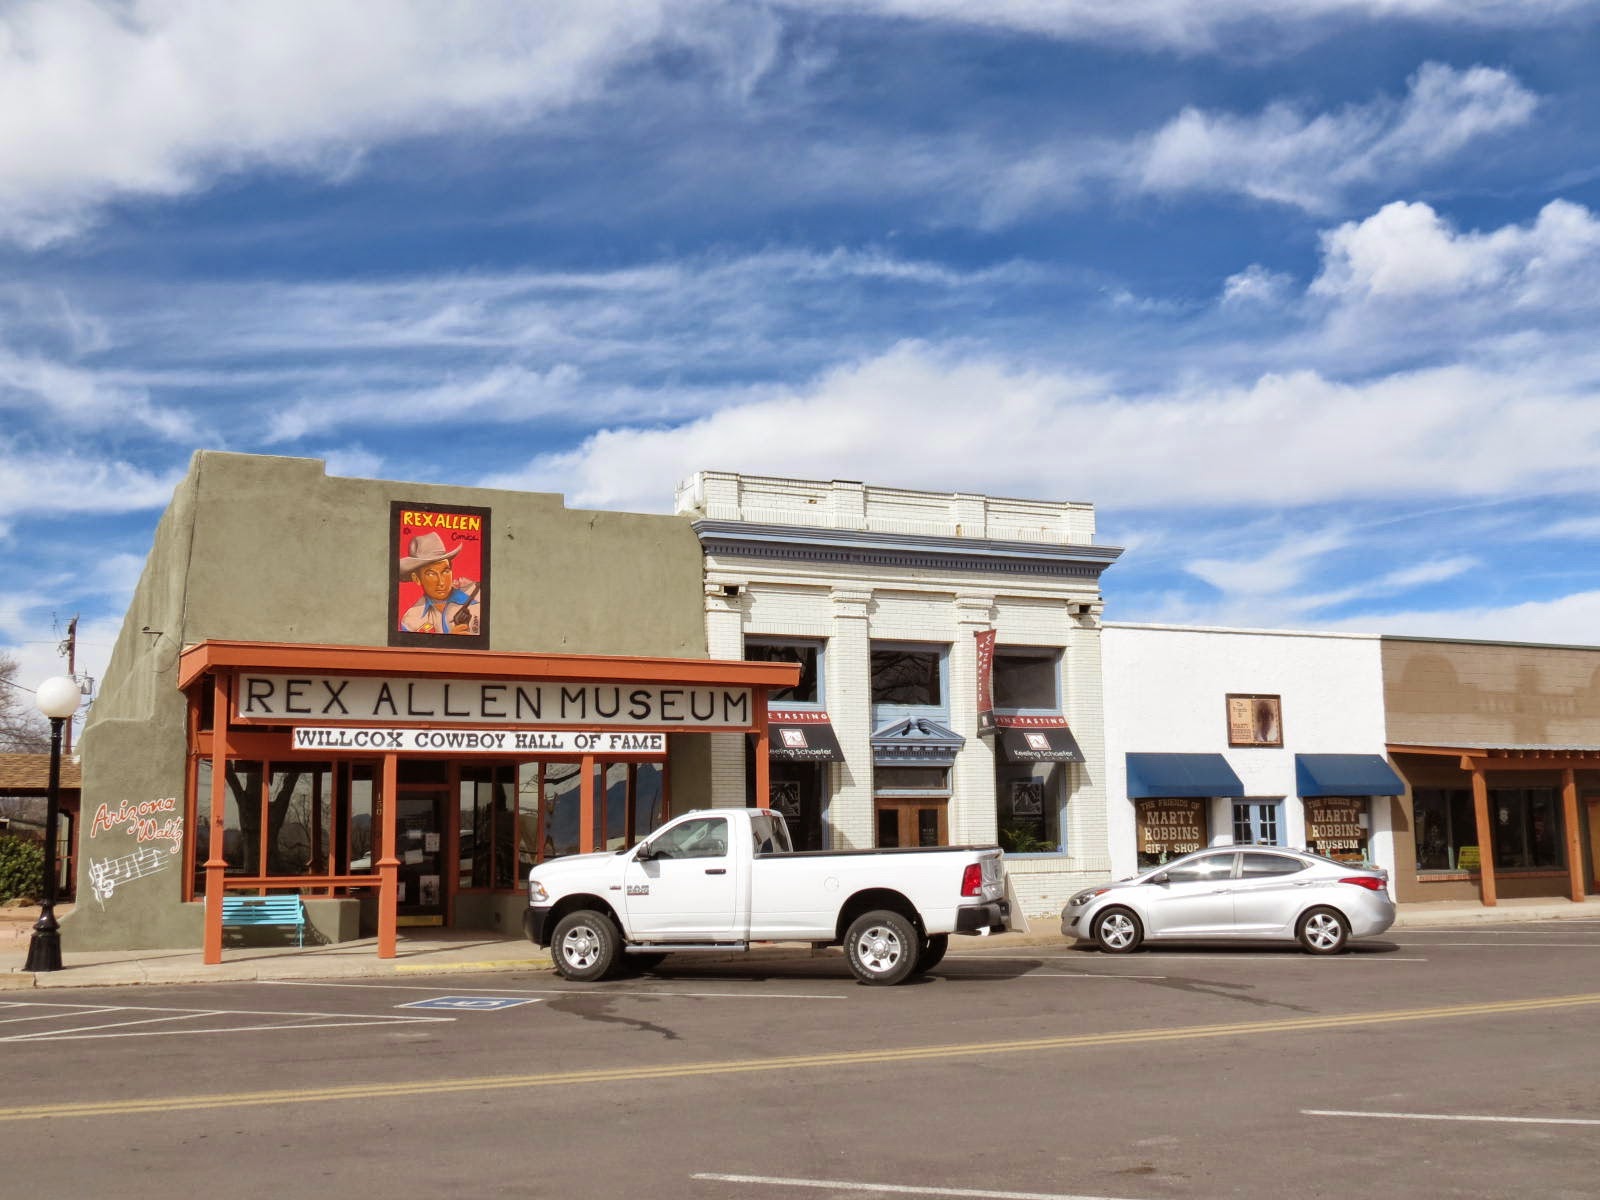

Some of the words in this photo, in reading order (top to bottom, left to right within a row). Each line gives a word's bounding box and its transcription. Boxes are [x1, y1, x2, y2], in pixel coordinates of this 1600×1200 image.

[403, 511, 433, 527] REX
[434, 513, 480, 531] ALLEN
[245, 678, 349, 714] REX
[372, 682, 542, 719] ALLEN
[560, 686, 748, 722] MUSEUM
[296, 730, 403, 748] WILLCOX
[414, 732, 505, 749] COWBOY
[515, 734, 564, 749] HALL
[574, 734, 601, 749] OF
[609, 735, 662, 750] FAME
[769, 748, 795, 756] eeling
[90, 797, 176, 839] Arizona
[1146, 811, 1194, 825] MARTY
[1313, 809, 1356, 822] MARTY
[136, 815, 184, 854] Waltz
[1144, 826, 1200, 840] ROBBINS
[1312, 823, 1361, 838] ROBBINS
[1145, 843, 1168, 854] GIFT
[1174, 843, 1200, 853] SHOP
[1316, 839, 1359, 850] MUSEUM
